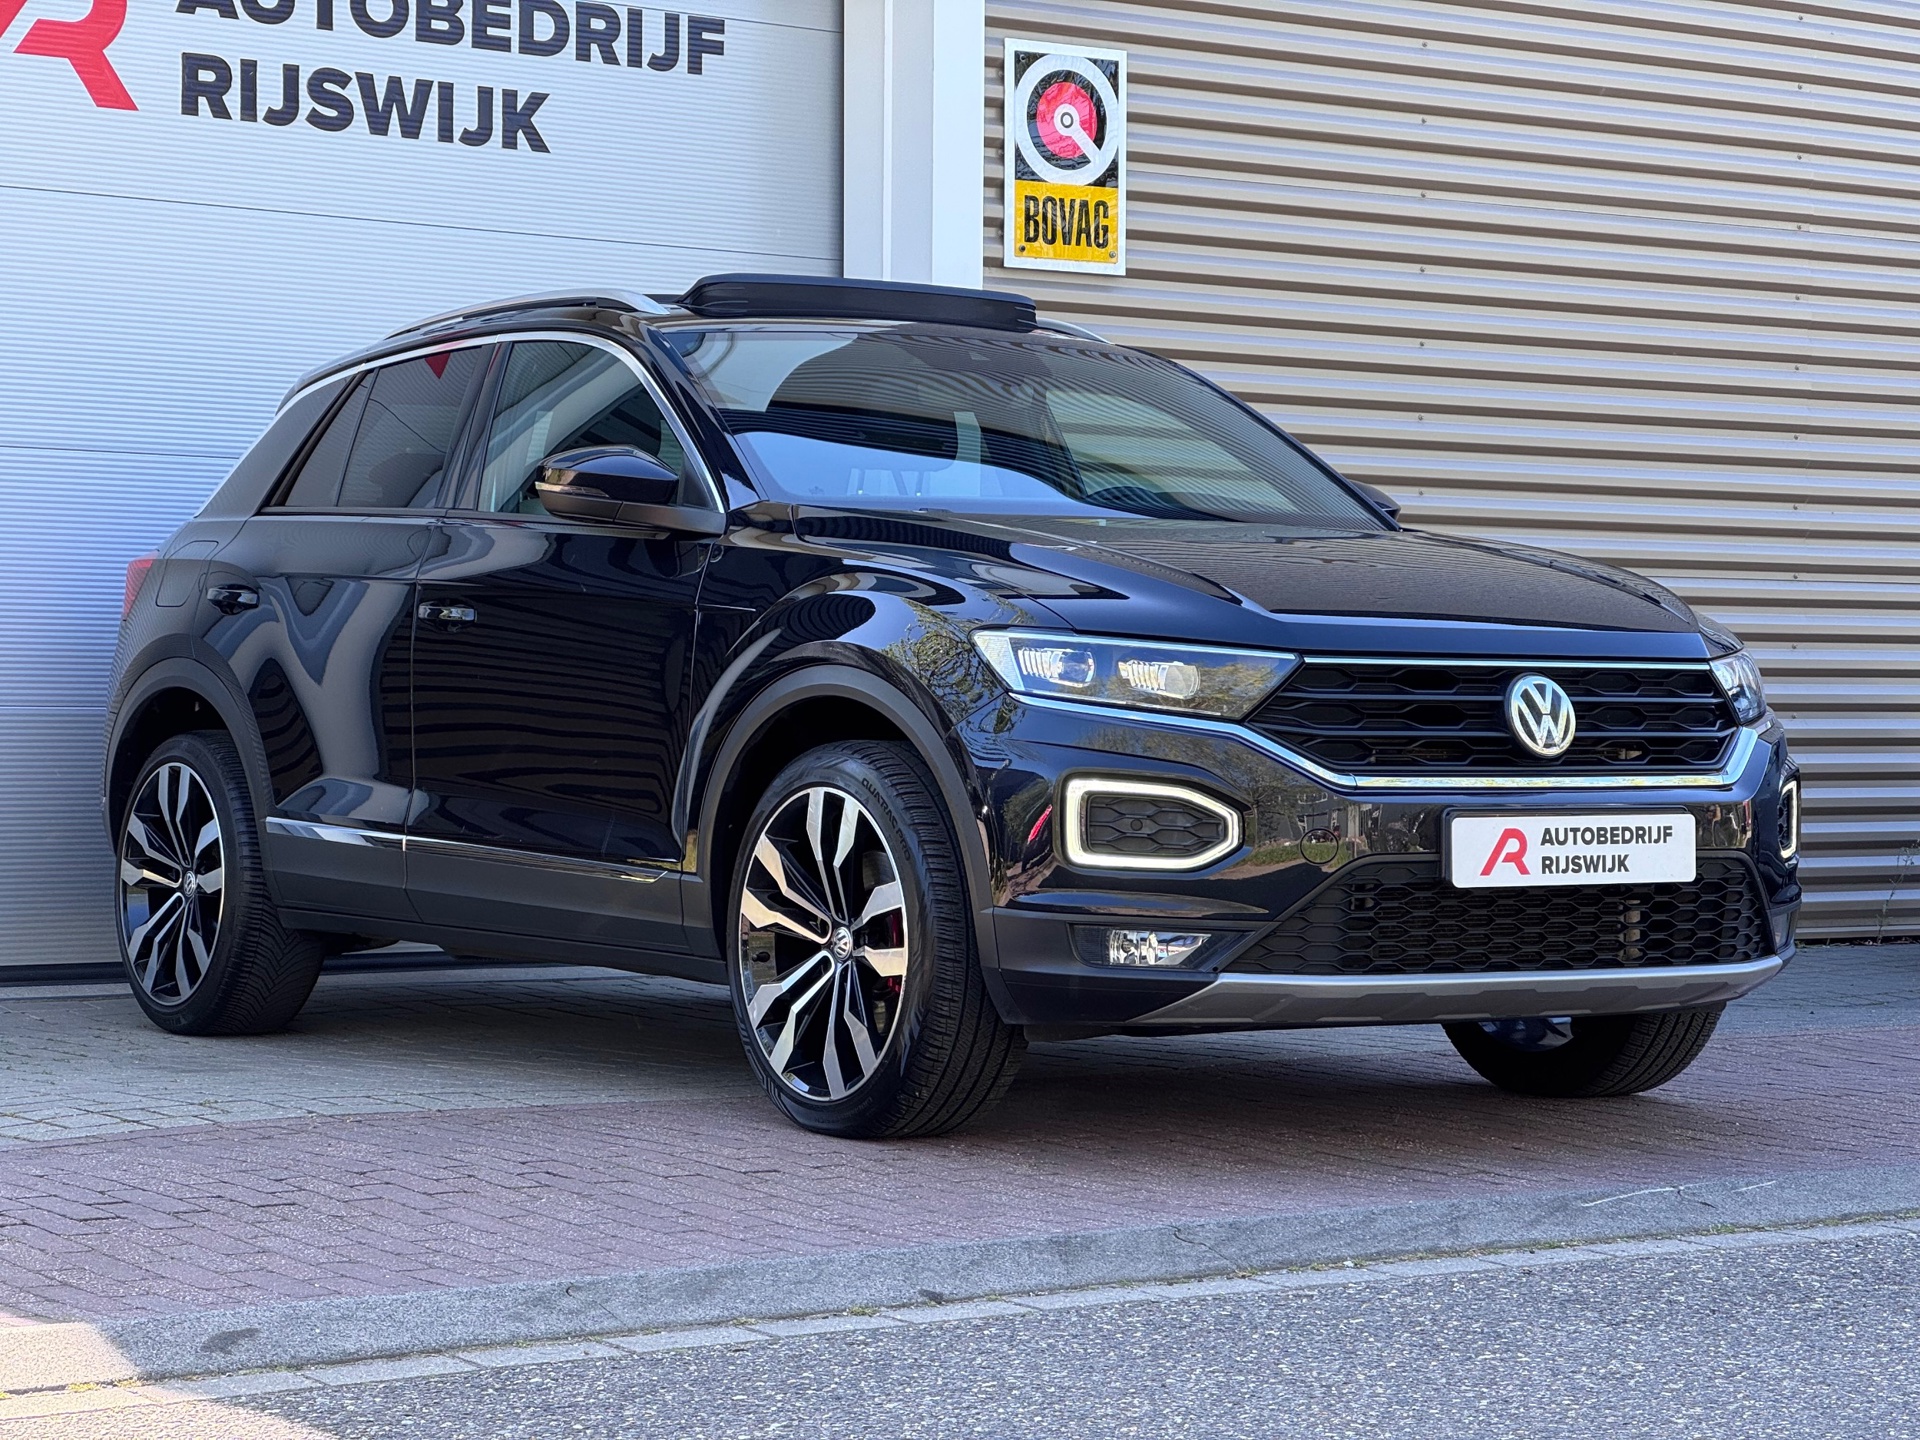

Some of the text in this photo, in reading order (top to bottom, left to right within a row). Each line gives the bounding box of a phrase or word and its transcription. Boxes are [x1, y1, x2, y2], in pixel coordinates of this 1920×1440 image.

[175, 0, 725, 76] OBEDRIJF
[180, 51, 552, 154] RIJSWIJK
[1023, 194, 1110, 249] BOVAG
[1540, 825, 1673, 846] AUTOBEDRIJF
[1541, 854, 1630, 875] RIJSWIJK
